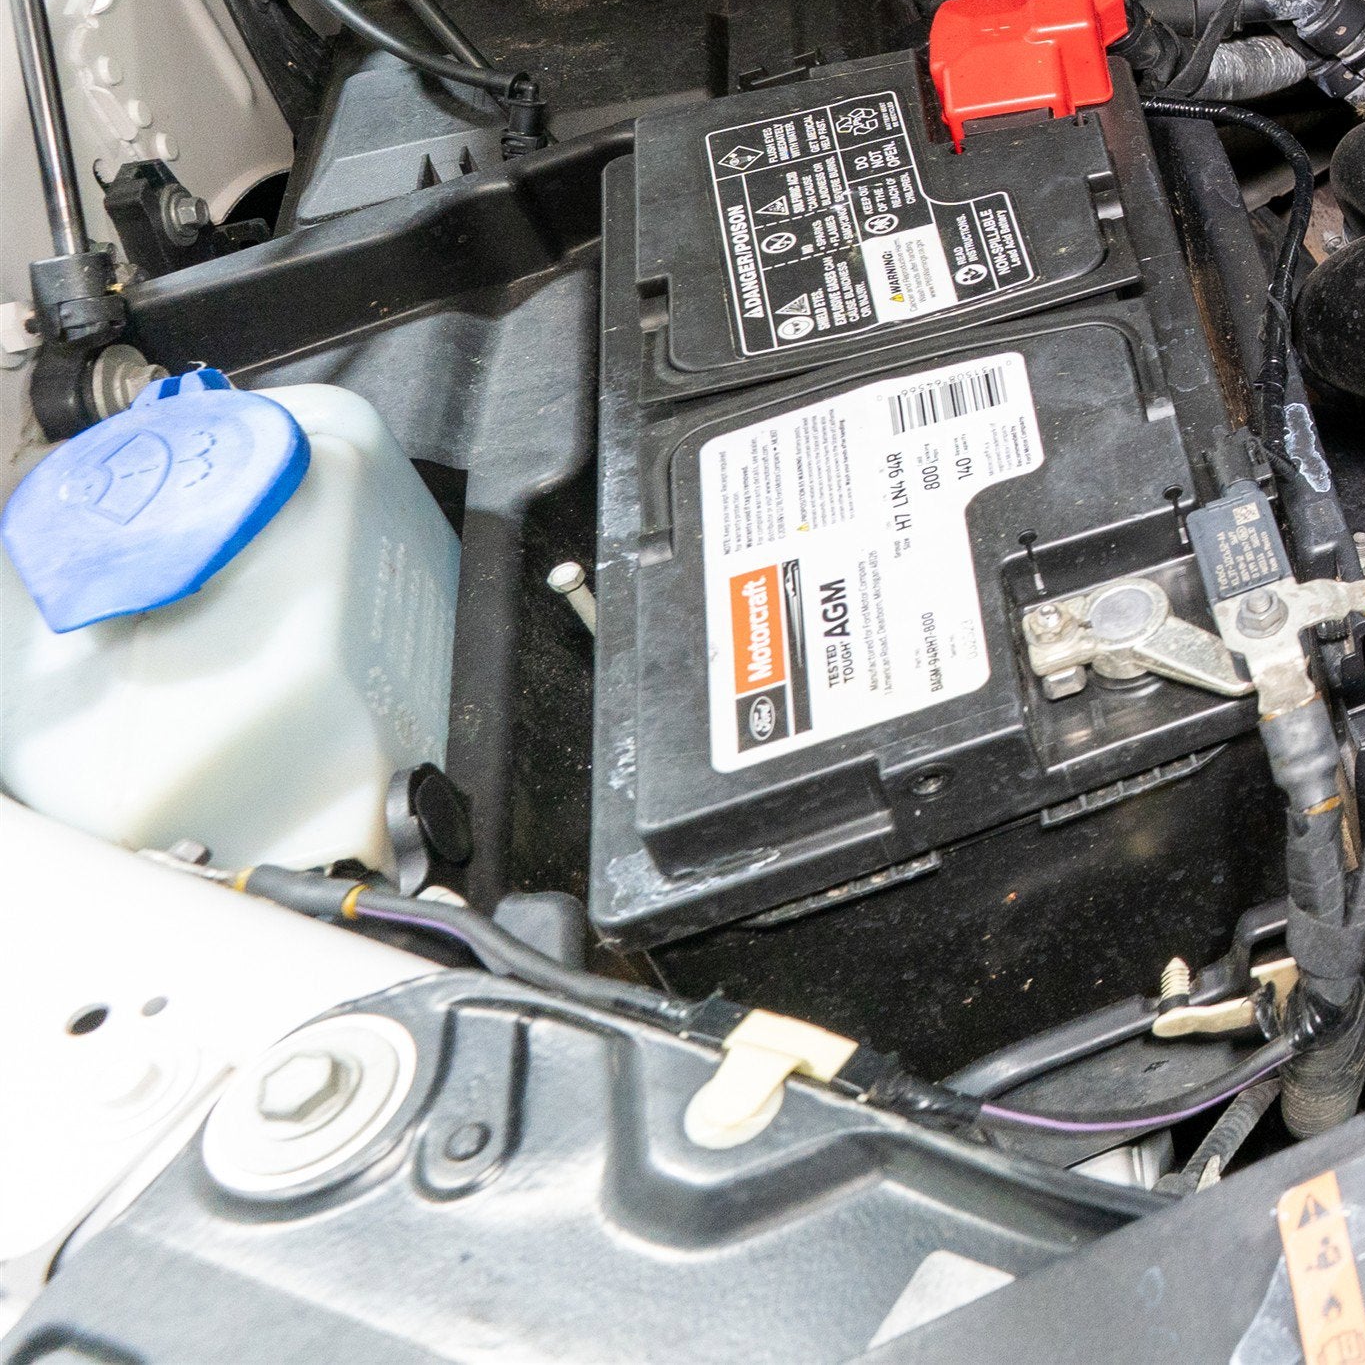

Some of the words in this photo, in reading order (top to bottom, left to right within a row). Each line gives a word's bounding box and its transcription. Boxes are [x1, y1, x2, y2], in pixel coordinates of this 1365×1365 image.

[854, 155, 869, 170] DO
[867, 148, 885, 168] NOT
[882, 140, 900, 168] OPEN.
[785, 170, 798, 185] ACID
[802, 174, 815, 196] CAUSE
[995, 208, 1011, 233] Battery
[979, 208, 1010, 275] NON-SPILLABLE
[1000, 233, 1015, 249] Acid
[726, 203, 762, 309] DANGER/POISON
[822, 255, 834, 271] CAN
[952, 246, 967, 265] READ
[1006, 248, 1021, 267] Lead
[823, 270, 839, 292] GASES
[881, 249, 902, 294] WARNING:
[814, 306, 830, 330] SHIELD
[828, 290, 847, 326] EXPLOSIVE
[844, 298, 860, 322] CAUSE
[859, 304, 872, 317] OR
[885, 450, 904, 479] 94R
[955, 455, 974, 479] 140
[921, 464, 940, 491] 800
[889, 479, 908, 508] LN4
[893, 511, 912, 531] H7
[819, 578, 850, 638] AGM
[859, 590, 870, 612] Motor
[742, 575, 773, 683] Motorcraft
[860, 611, 871, 628] Ford
[825, 643, 839, 687] TESTED
